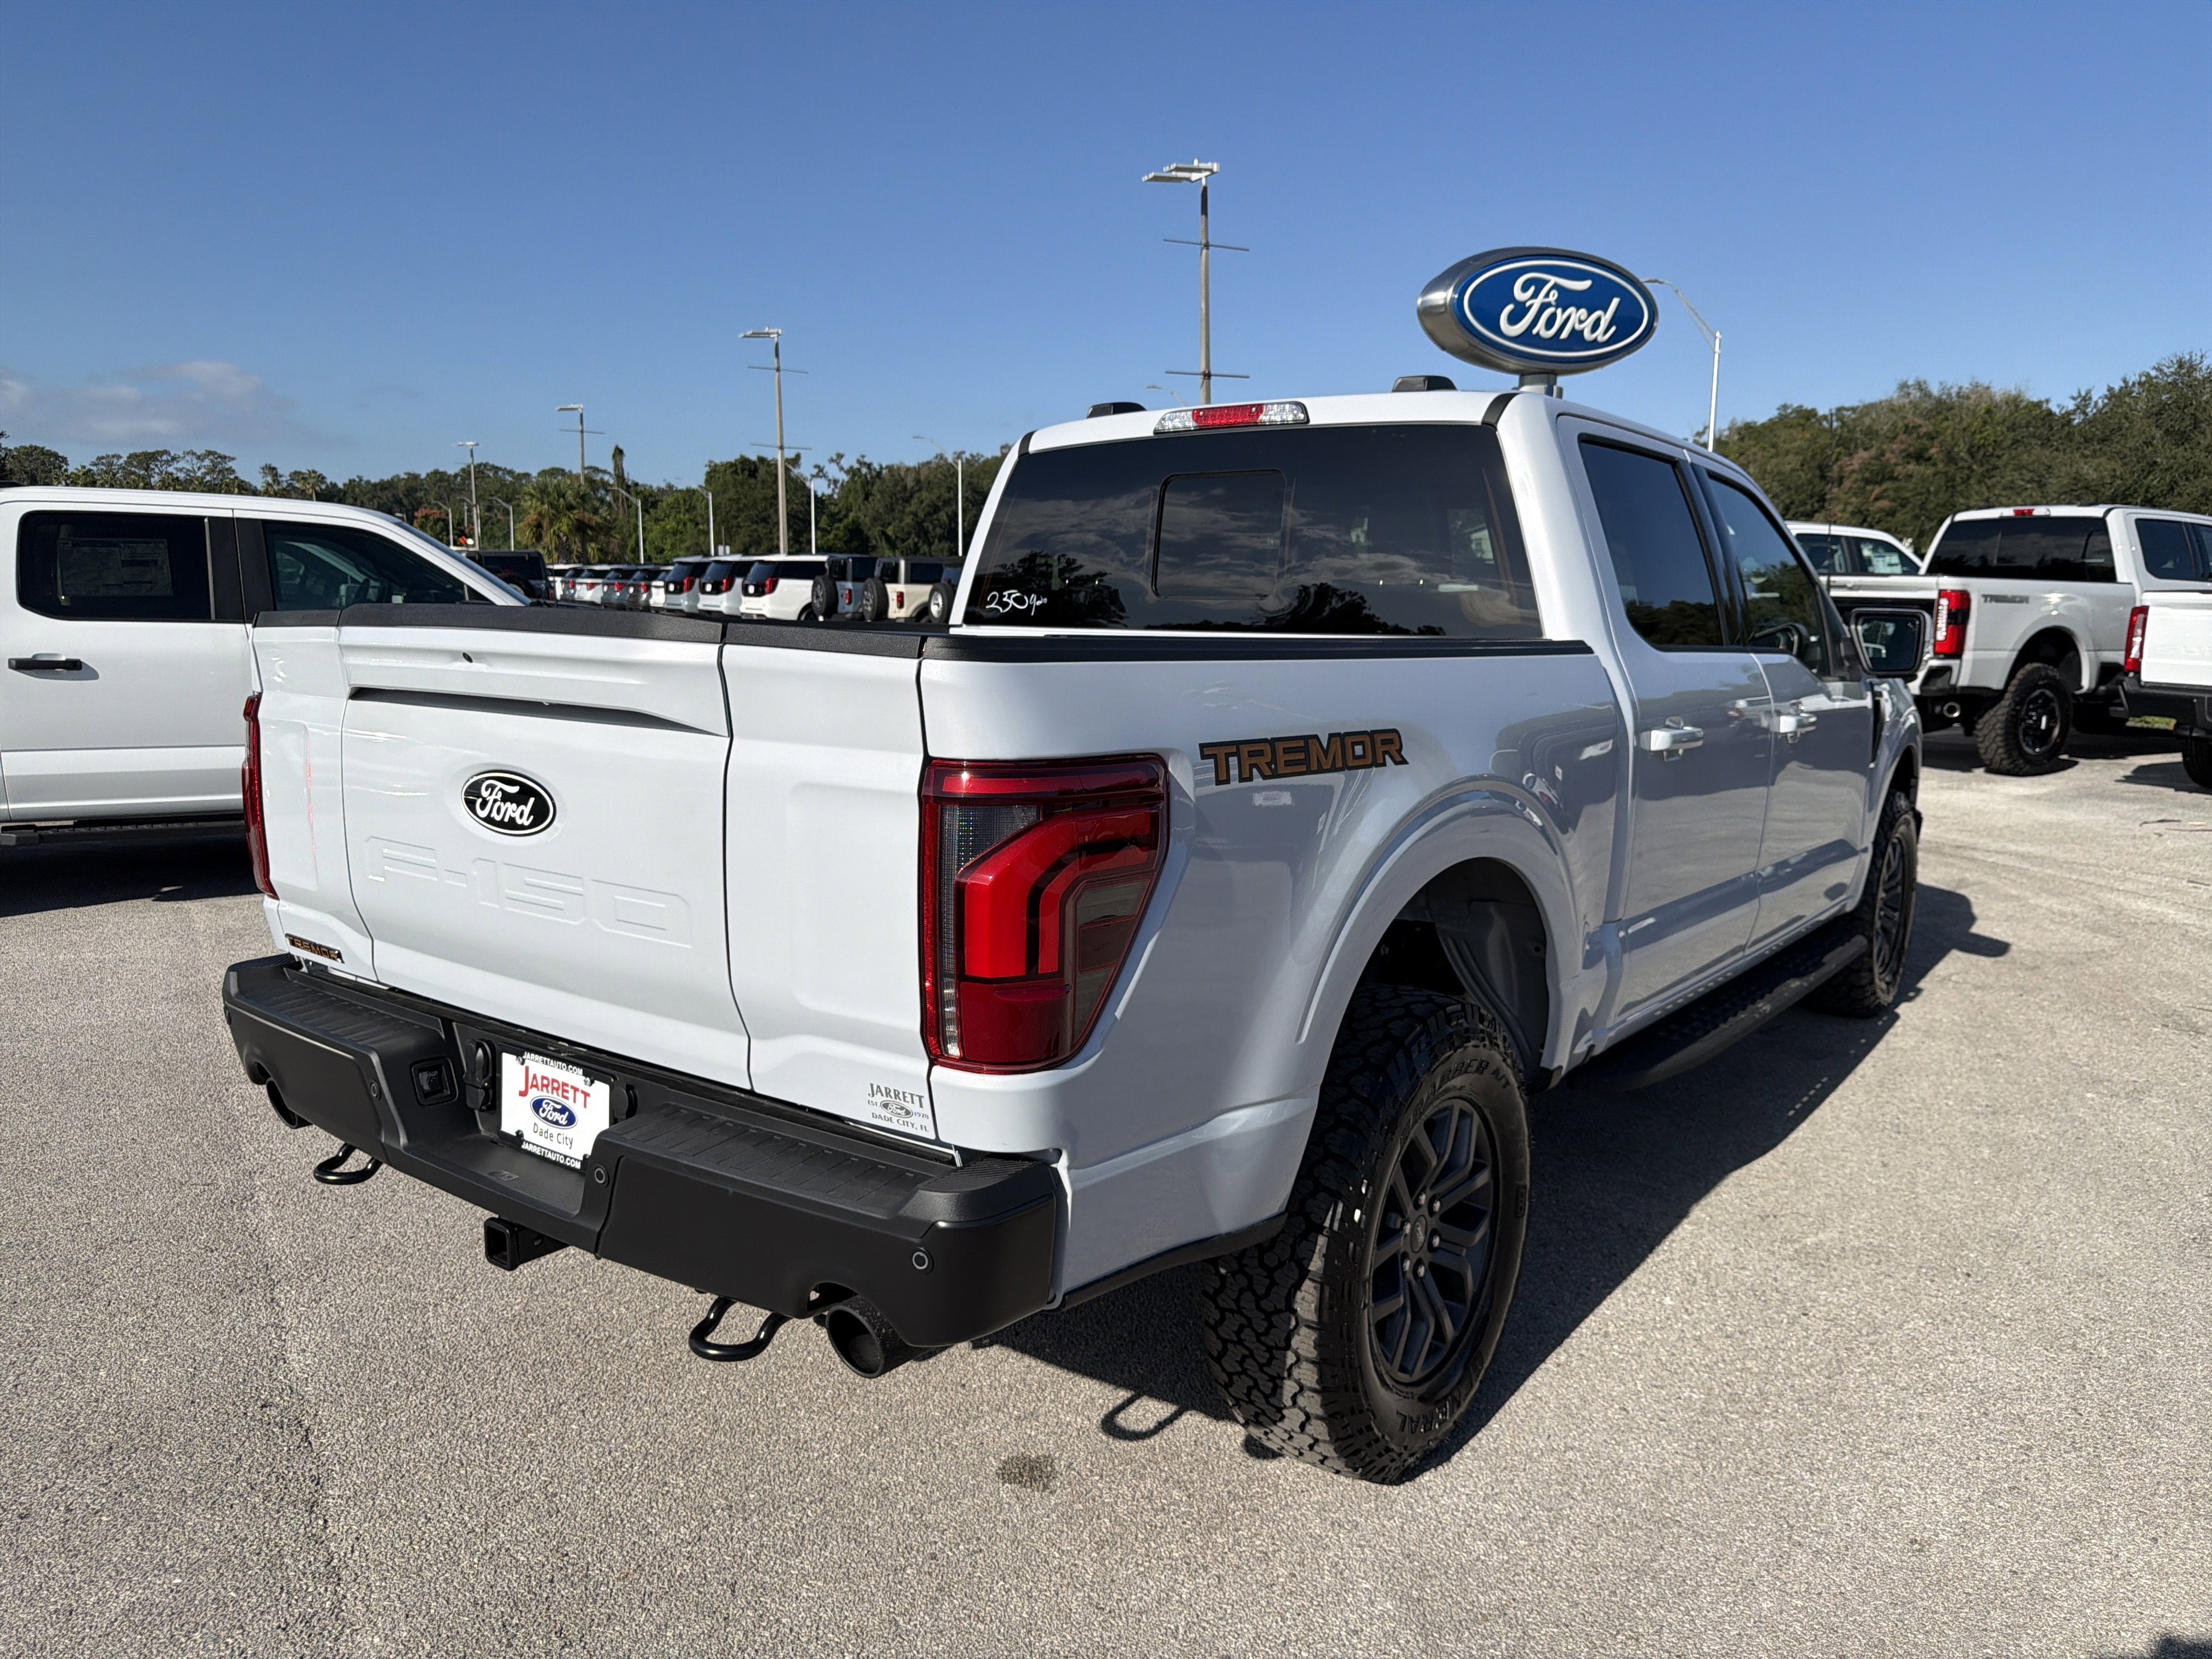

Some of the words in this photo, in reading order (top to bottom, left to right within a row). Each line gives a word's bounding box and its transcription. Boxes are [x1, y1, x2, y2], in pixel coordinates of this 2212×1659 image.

[1499, 272, 1621, 343] Ford
[1200, 729, 1407, 785] TREMOR
[476, 779, 535, 826] Ford
[364, 836, 693, 949] F-150
[285, 934, 342, 963] TREMOR
[523, 1051, 583, 1075] JARRETTAUTO.COM
[518, 1065, 591, 1109] JARRETT
[868, 1083, 924, 1109] JARRETT
[539, 1099, 569, 1125] Ford
[867, 1099, 881, 1108] EST.
[887, 1103, 906, 1116] Ford
[871, 1112, 895, 1123] DADE
[896, 1119, 918, 1130] CITY,
[533, 1122, 554, 1142] Dade
[557, 1131, 574, 1150] City
[521, 1141, 582, 1169] JARRETTAUTO.COM
